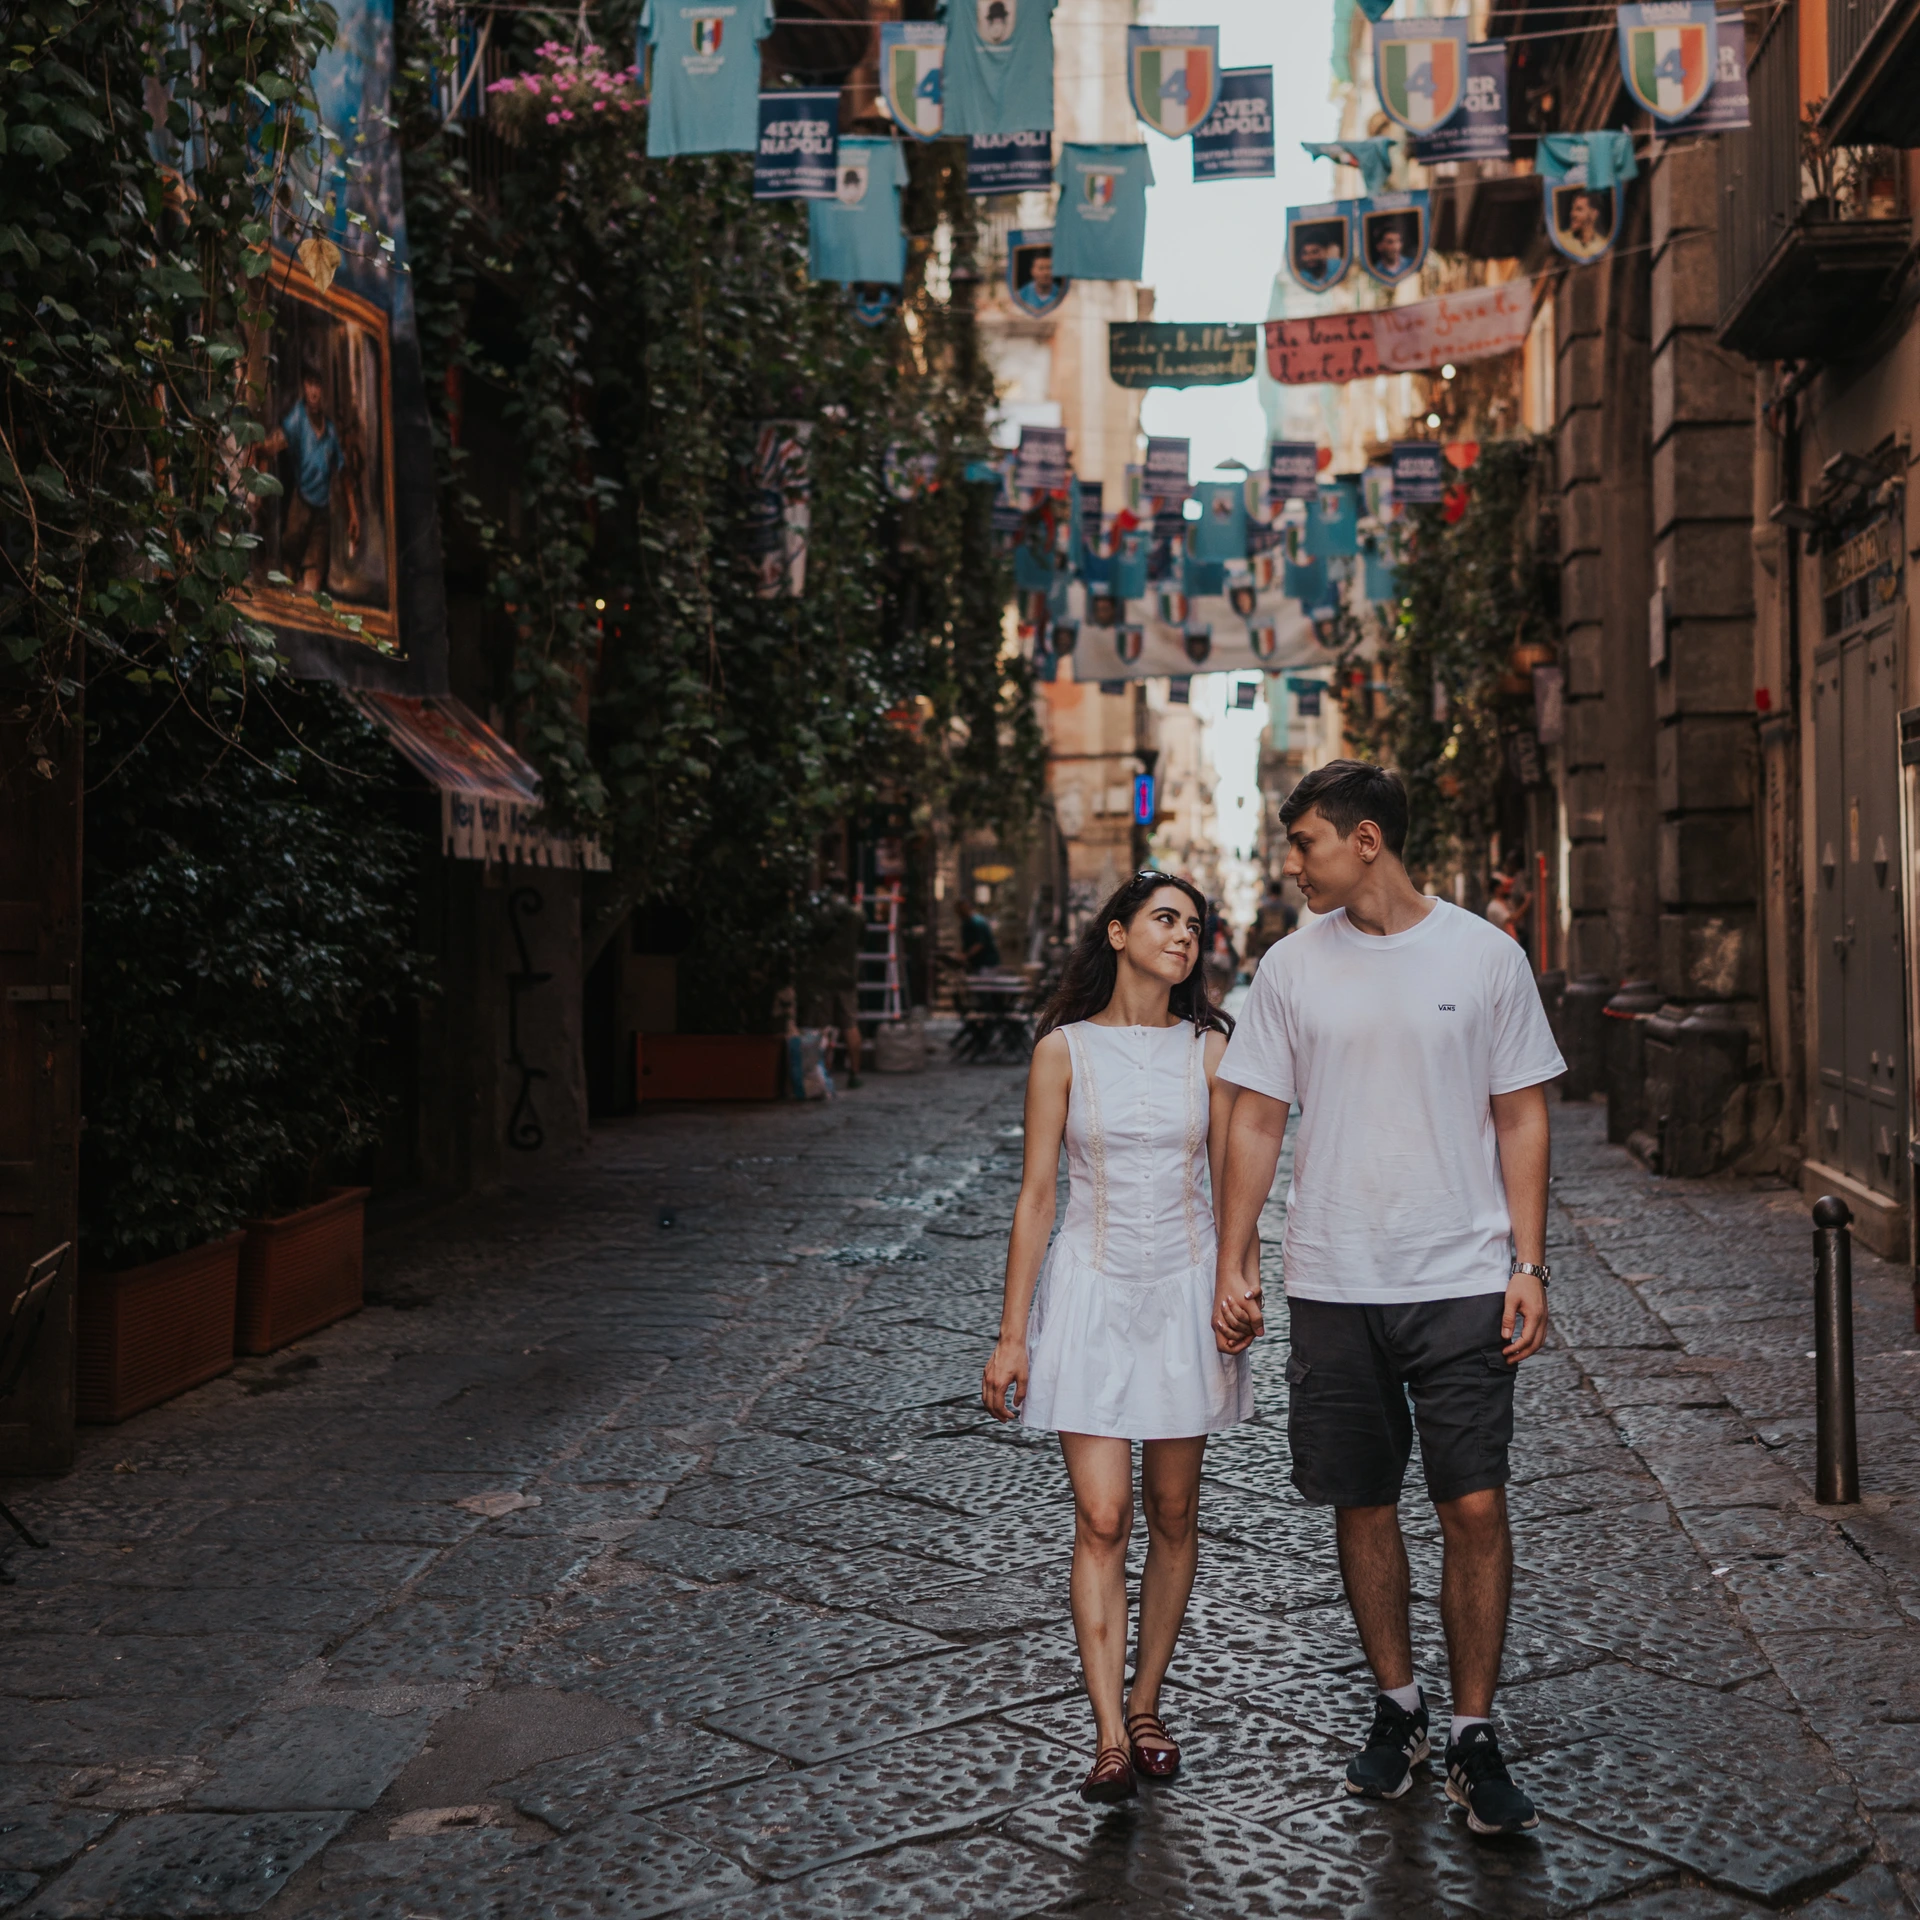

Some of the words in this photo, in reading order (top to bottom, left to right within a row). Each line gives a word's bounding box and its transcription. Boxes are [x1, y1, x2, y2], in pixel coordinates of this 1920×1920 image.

[1654, 48, 1686, 84] 4
[1158, 69, 1191, 104] 4
[1405, 62, 1437, 97] 4
[764, 120, 830, 137] 4EVER
[760, 137, 834, 154] NAPOLI
[973, 131, 1048, 149] NAPOLI
[1437, 1003, 1456, 1012] VANS
